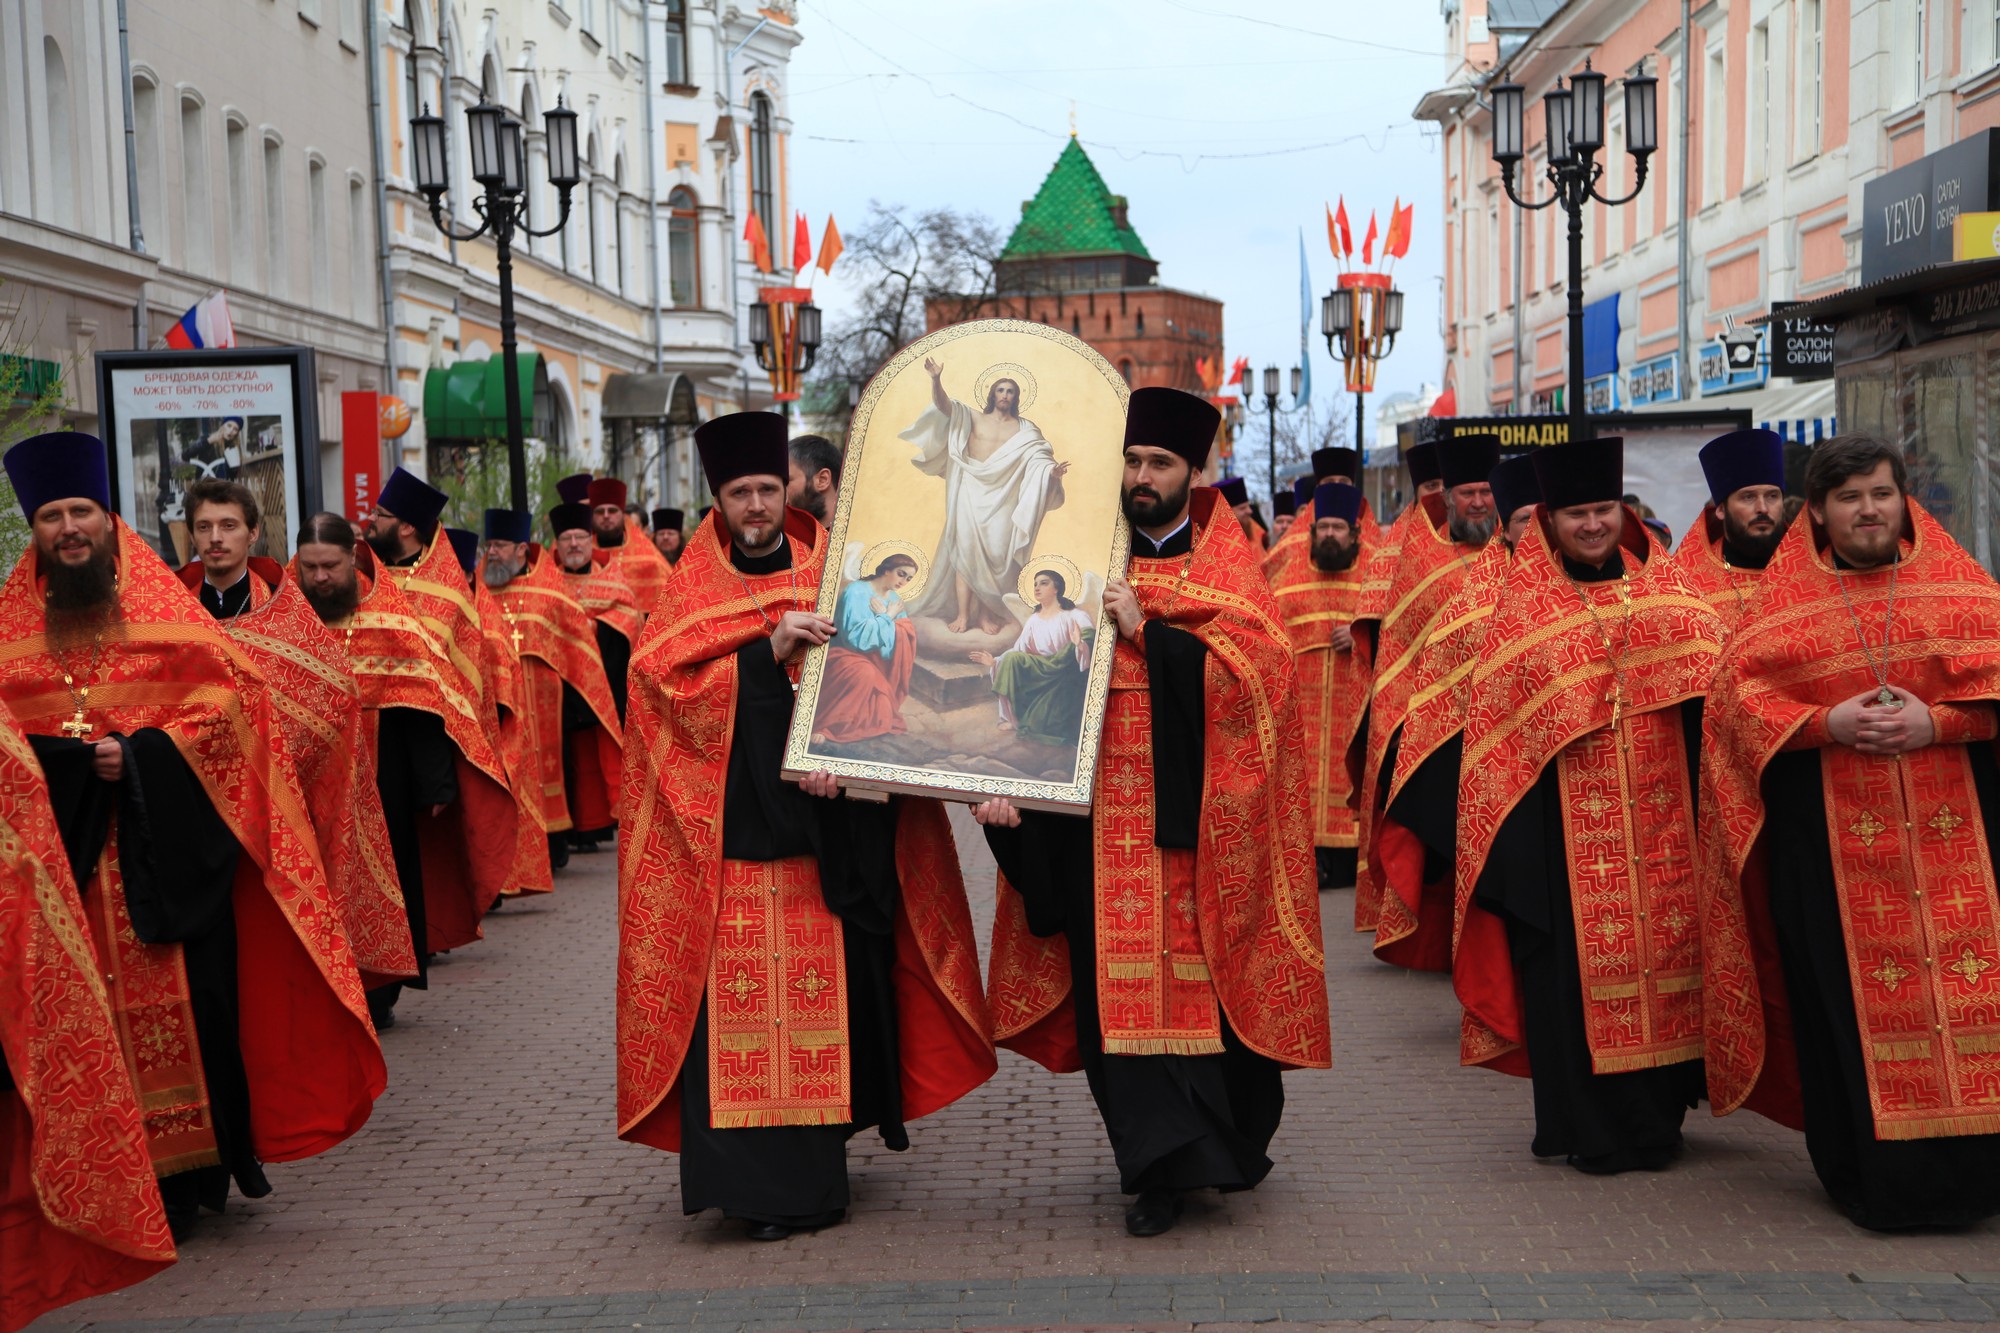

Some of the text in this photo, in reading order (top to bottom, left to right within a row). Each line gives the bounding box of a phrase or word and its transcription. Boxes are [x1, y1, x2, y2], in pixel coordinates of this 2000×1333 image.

[1937, 177, 1961, 204] САЛОН
[1884, 193, 1926, 246] YEYO
[1931, 292, 1953, 322] ЭЛЬ
[1786, 336, 1833, 350] САЛОН
[1786, 350, 1833, 364] ОБУВИ
[144, 370, 259, 383] БРЕНДОВАЯ ОДЕЖДА
[133, 382, 274, 396] МОЖЕТ БЫТЬ ДОСТУПНОЙ
[154, 399, 255, 411] -60% -70% -80%
